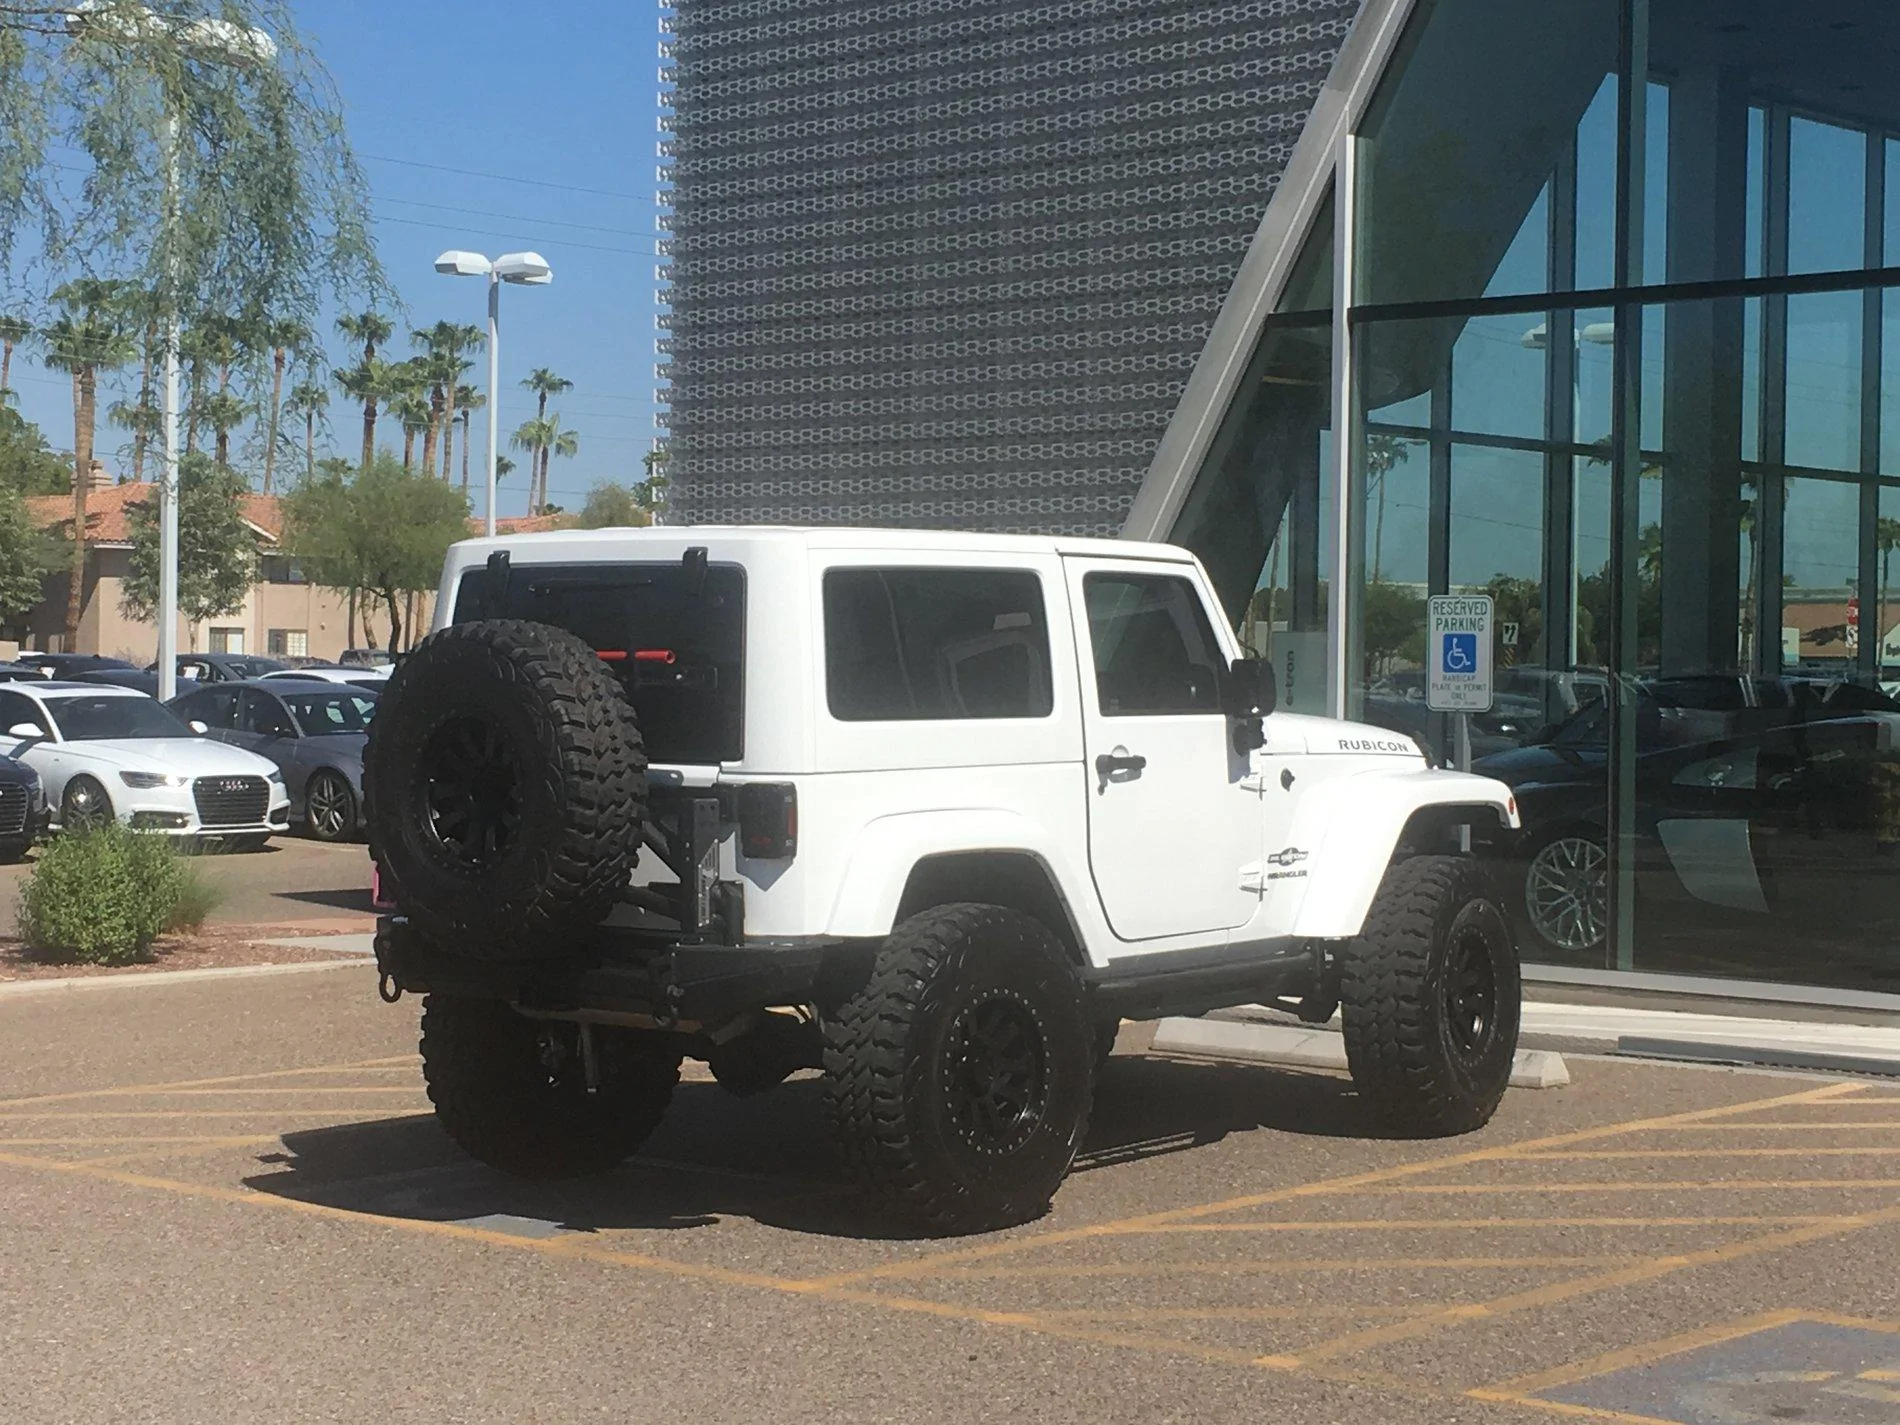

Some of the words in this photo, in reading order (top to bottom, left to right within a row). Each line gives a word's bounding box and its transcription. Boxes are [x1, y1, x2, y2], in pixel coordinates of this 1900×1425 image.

[1432, 601, 1488, 616] RESERVED
[1435, 618, 1485, 632] PARKING
[1338, 739, 1409, 752] RUBICON
[1267, 870, 1308, 881] WRANGLER
